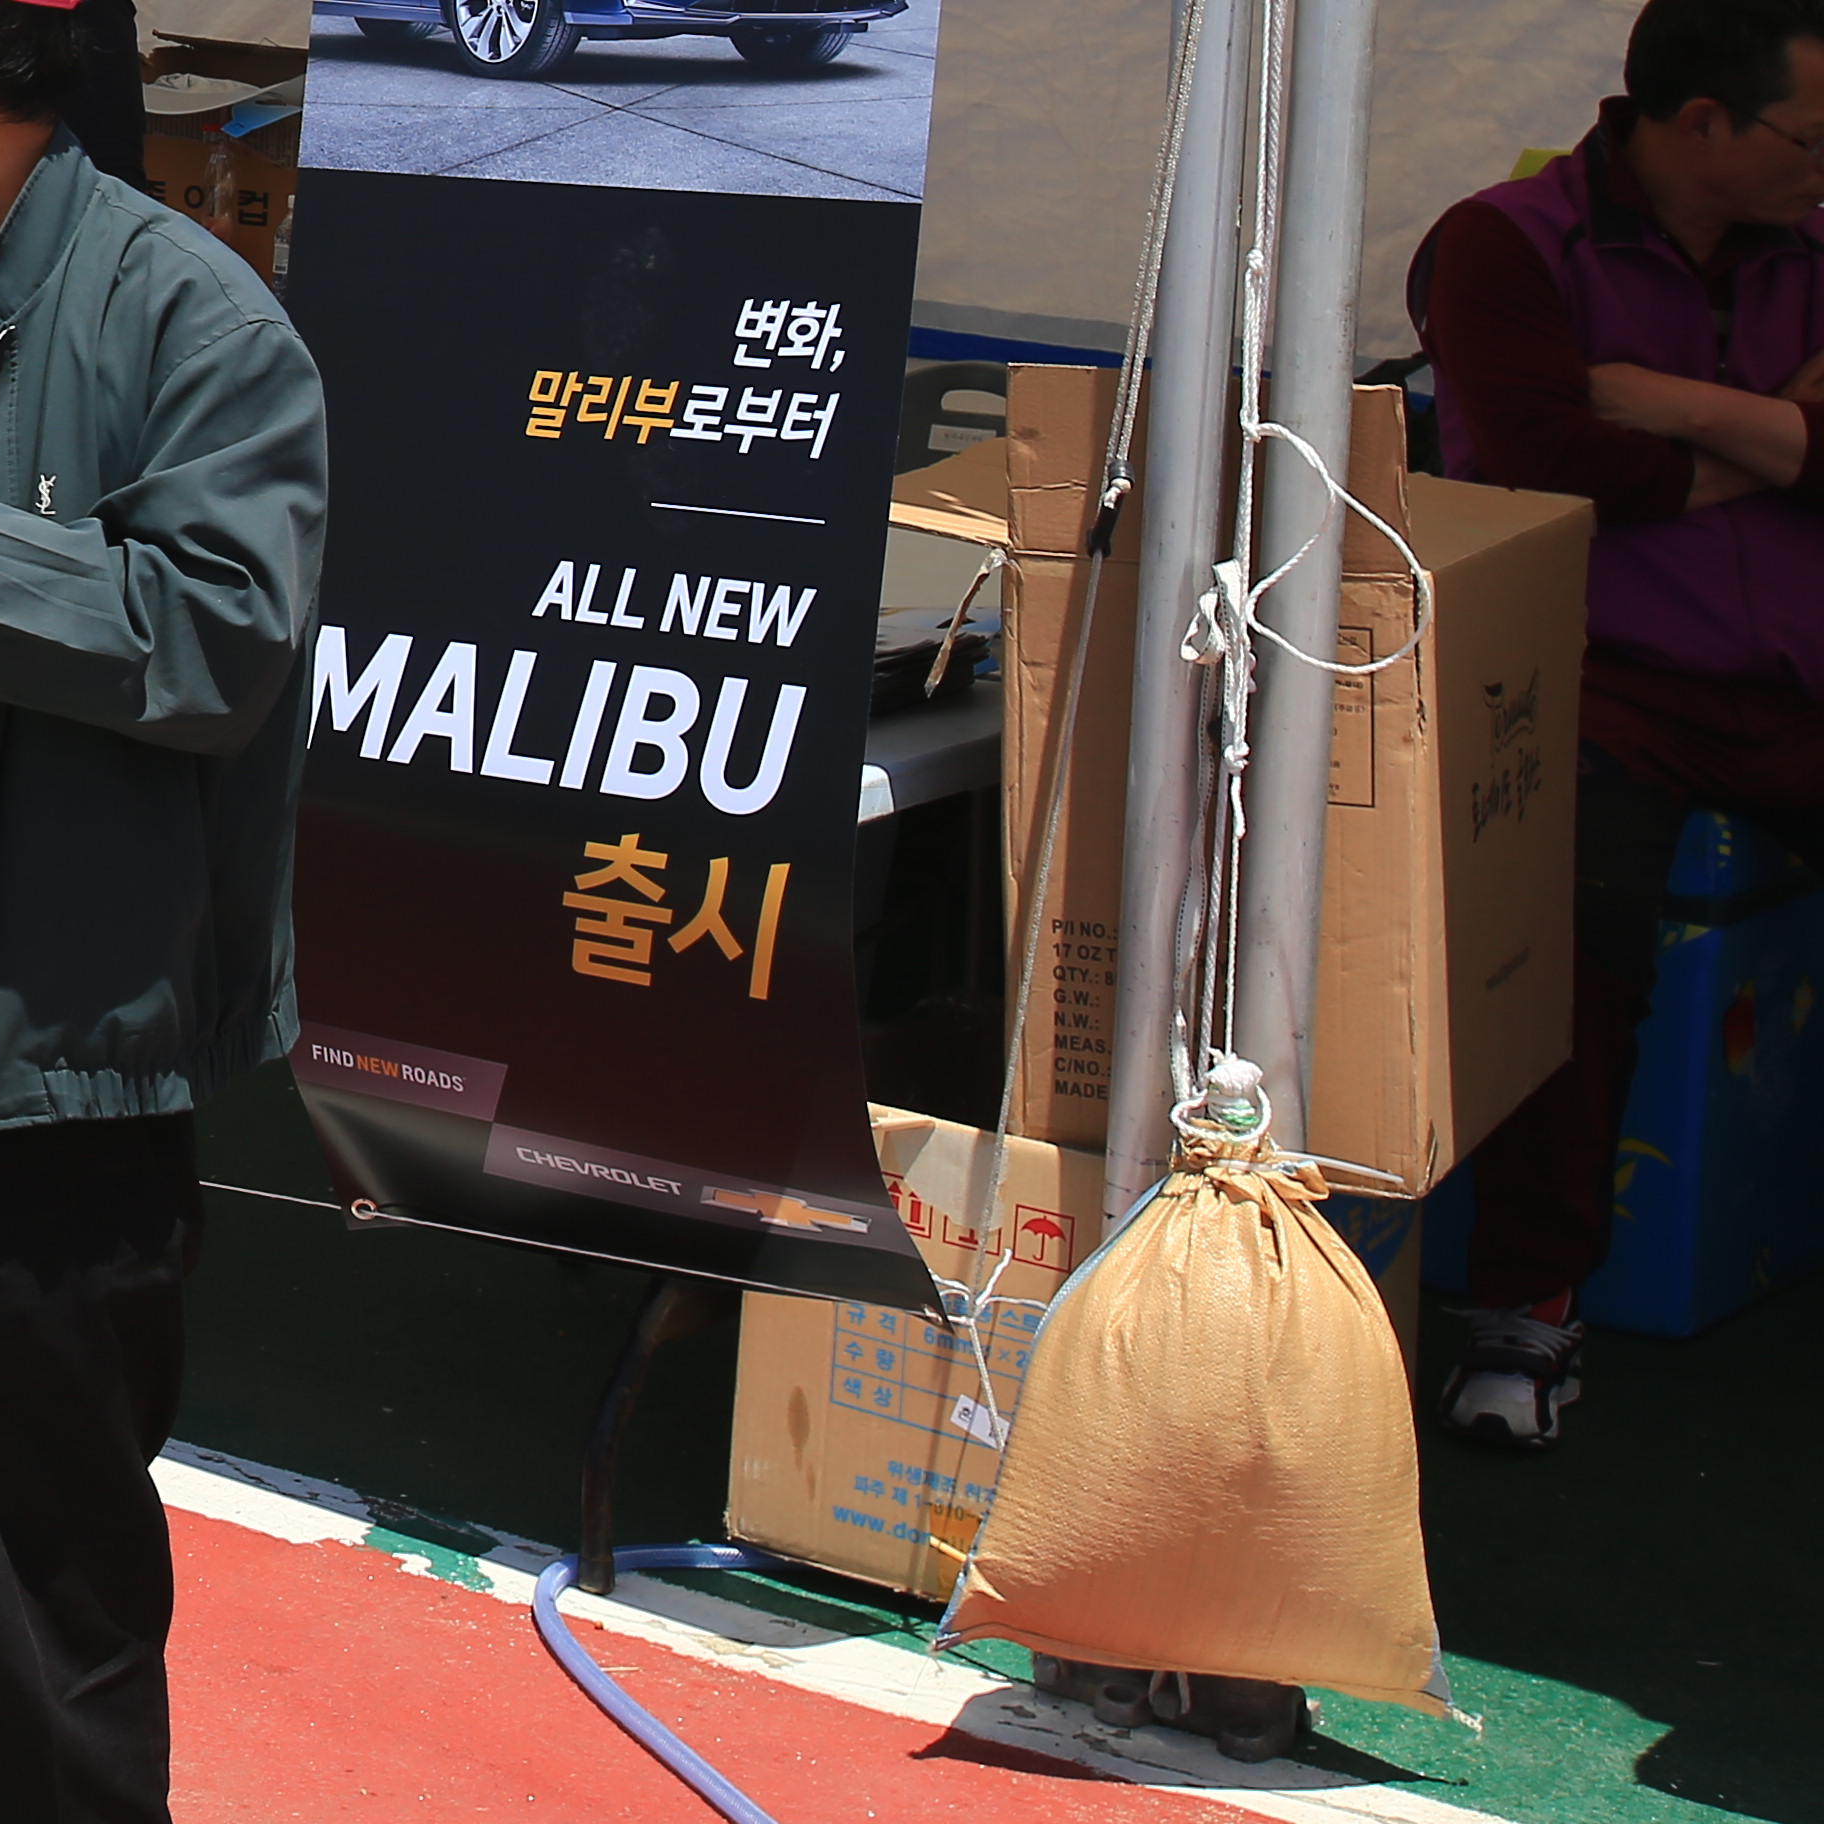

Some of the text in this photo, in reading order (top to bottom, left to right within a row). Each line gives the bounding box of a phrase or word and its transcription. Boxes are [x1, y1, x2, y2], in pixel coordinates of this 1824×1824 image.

[733, 298, 846, 373] 변화,
[525, 369, 840, 460] 말리부로부터
[531, 560, 818, 648] ALL NEW
[307, 623, 808, 816] MALIBU
[562, 832, 791, 1001] 출시
[1052, 919, 1075, 936] P/I
[1052, 943, 1072, 958] 17
[1076, 945, 1102, 962] OZ
[1052, 965, 1100, 985] QTY.:
[1053, 988, 1100, 1008] G.W.:
[1053, 1010, 1100, 1030] N.W.:
[312, 1043, 465, 1093] FIND NEW ROADS
[1054, 1056, 1111, 1078] C/NO.:
[1054, 1079, 1109, 1100] MADE
[516, 1146, 682, 1197] CHEVROLET
